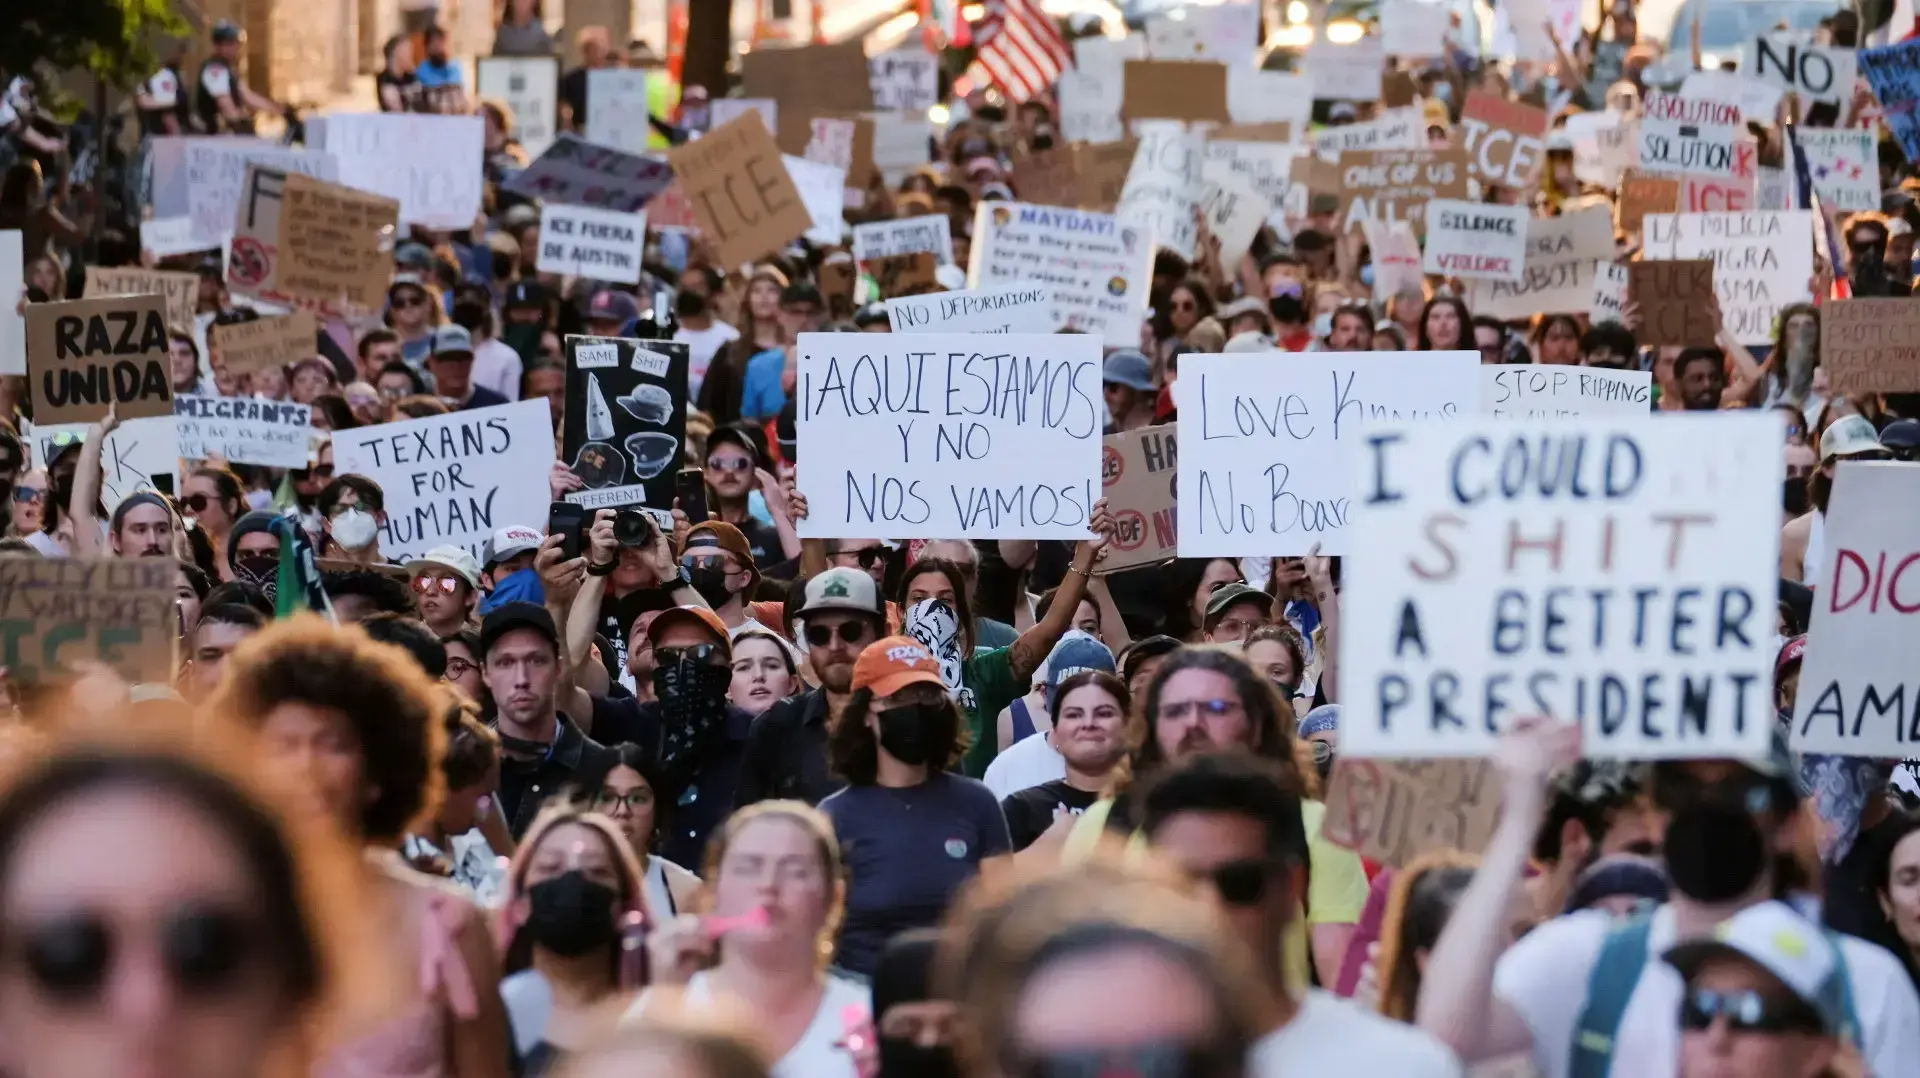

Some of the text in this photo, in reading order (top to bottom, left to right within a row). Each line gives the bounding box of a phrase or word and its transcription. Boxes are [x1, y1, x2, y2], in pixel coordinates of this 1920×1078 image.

[1756, 38, 1834, 93] NO
[1644, 91, 1741, 125] REVOLUTION
[1640, 134, 1732, 170] SOLUTION
[1344, 161, 1456, 188] ONE OF US
[694, 153, 795, 243] ICE
[1689, 180, 1747, 213] ICE
[551, 218, 634, 242] ICE FUERA
[1019, 208, 1114, 236] MAYDAY!
[1440, 211, 1517, 237] SILENCE
[1652, 213, 1782, 243] LA POLICIA
[544, 242, 563, 259] DE
[1019, 251, 1042, 264] my
[1039, 233, 1072, 250] they
[1077, 242, 1119, 255] came
[1698, 247, 1779, 271] MIGRA
[1437, 253, 1513, 274] VIOLENCE
[95, 275, 197, 299] WITHOUT
[1634, 266, 1706, 299] FUCK
[895, 304, 930, 330] NO
[939, 289, 1045, 321] DEPORTATIONS
[1658, 304, 1705, 345] CE
[54, 309, 170, 360] RAZA
[578, 347, 667, 373] SAME SHIT
[43, 360, 170, 408] UNIDA
[804, 353, 1097, 439] ¡AQUI ESTAMOS
[1494, 369, 1648, 403] STOP RIPPING
[175, 399, 307, 427] MIGRANTS
[1201, 371, 1315, 441] Love
[223, 442, 244, 459] ICE
[359, 417, 512, 468] TEXANS
[897, 418, 990, 463] Y NO
[411, 463, 475, 498] FOR
[1365, 430, 1645, 504] I COULD
[568, 488, 640, 506] DIFFERENT
[846, 470, 1092, 531] NOS VAMOS!
[1199, 469, 1255, 534] No
[378, 485, 499, 547] HUMAN
[1407, 513, 1714, 582] SHIT
[1392, 587, 1757, 660] A BETTER
[1377, 668, 1762, 741] PRESIDENT
